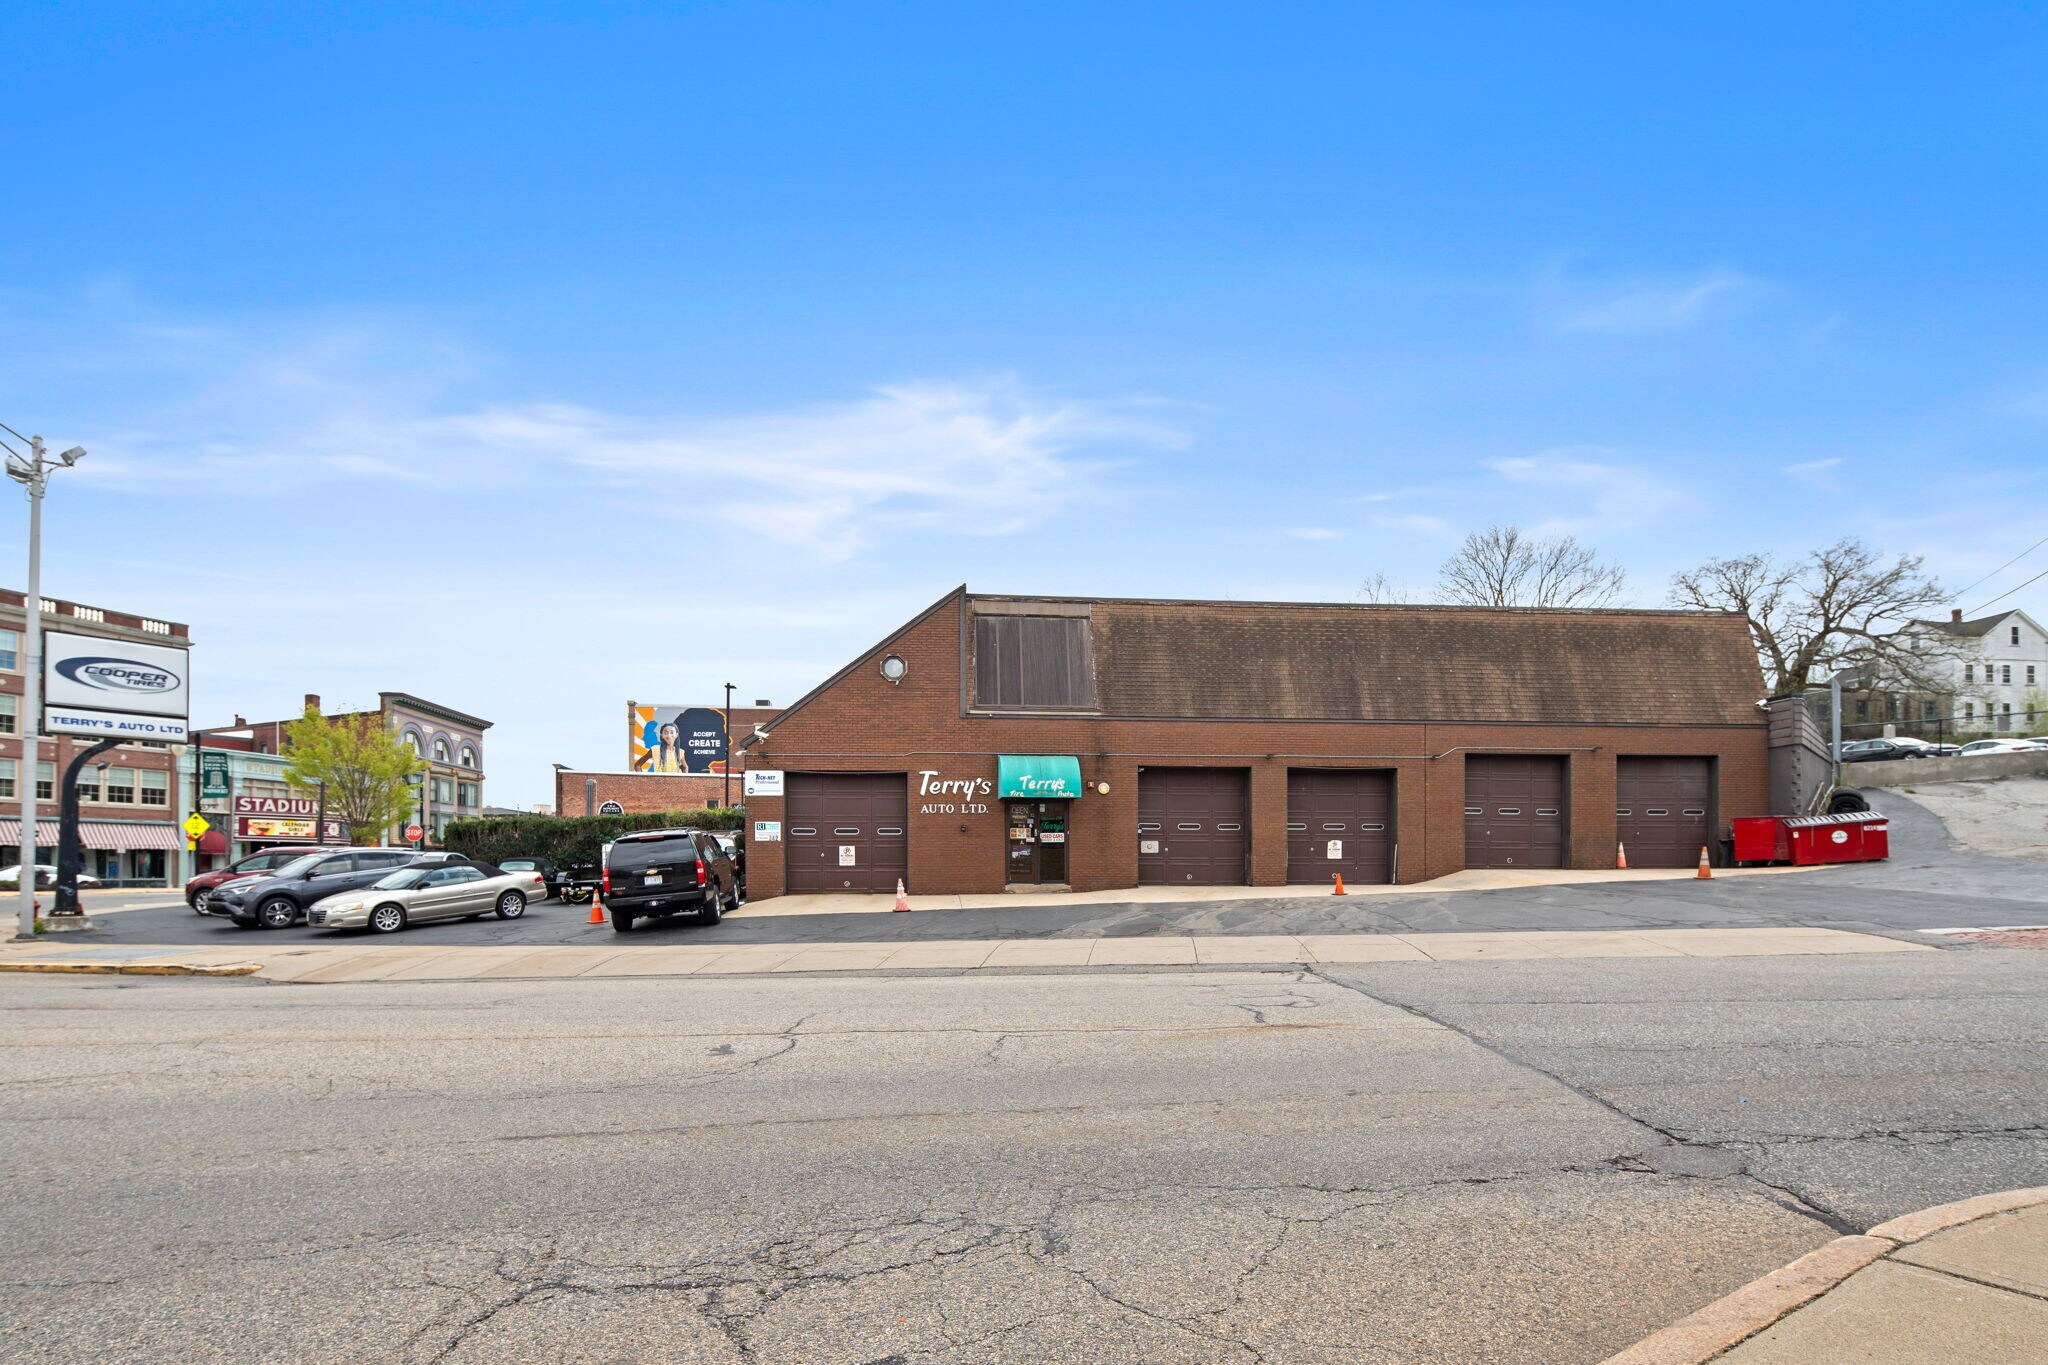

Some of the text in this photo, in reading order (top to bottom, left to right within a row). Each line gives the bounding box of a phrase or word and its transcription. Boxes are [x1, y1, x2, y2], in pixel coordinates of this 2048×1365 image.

[84, 666, 168, 682] COOPER
[126, 679, 166, 688] TIRES
[52, 716, 183, 734] TERRY'S AUTO LTD
[919, 770, 992, 802] Terry's
[1019, 775, 1066, 791] Terry's
[1009, 789, 1025, 797] Tire
[920, 804, 989, 813] AUTO LTD.
[407, 829, 422, 837] STOP
